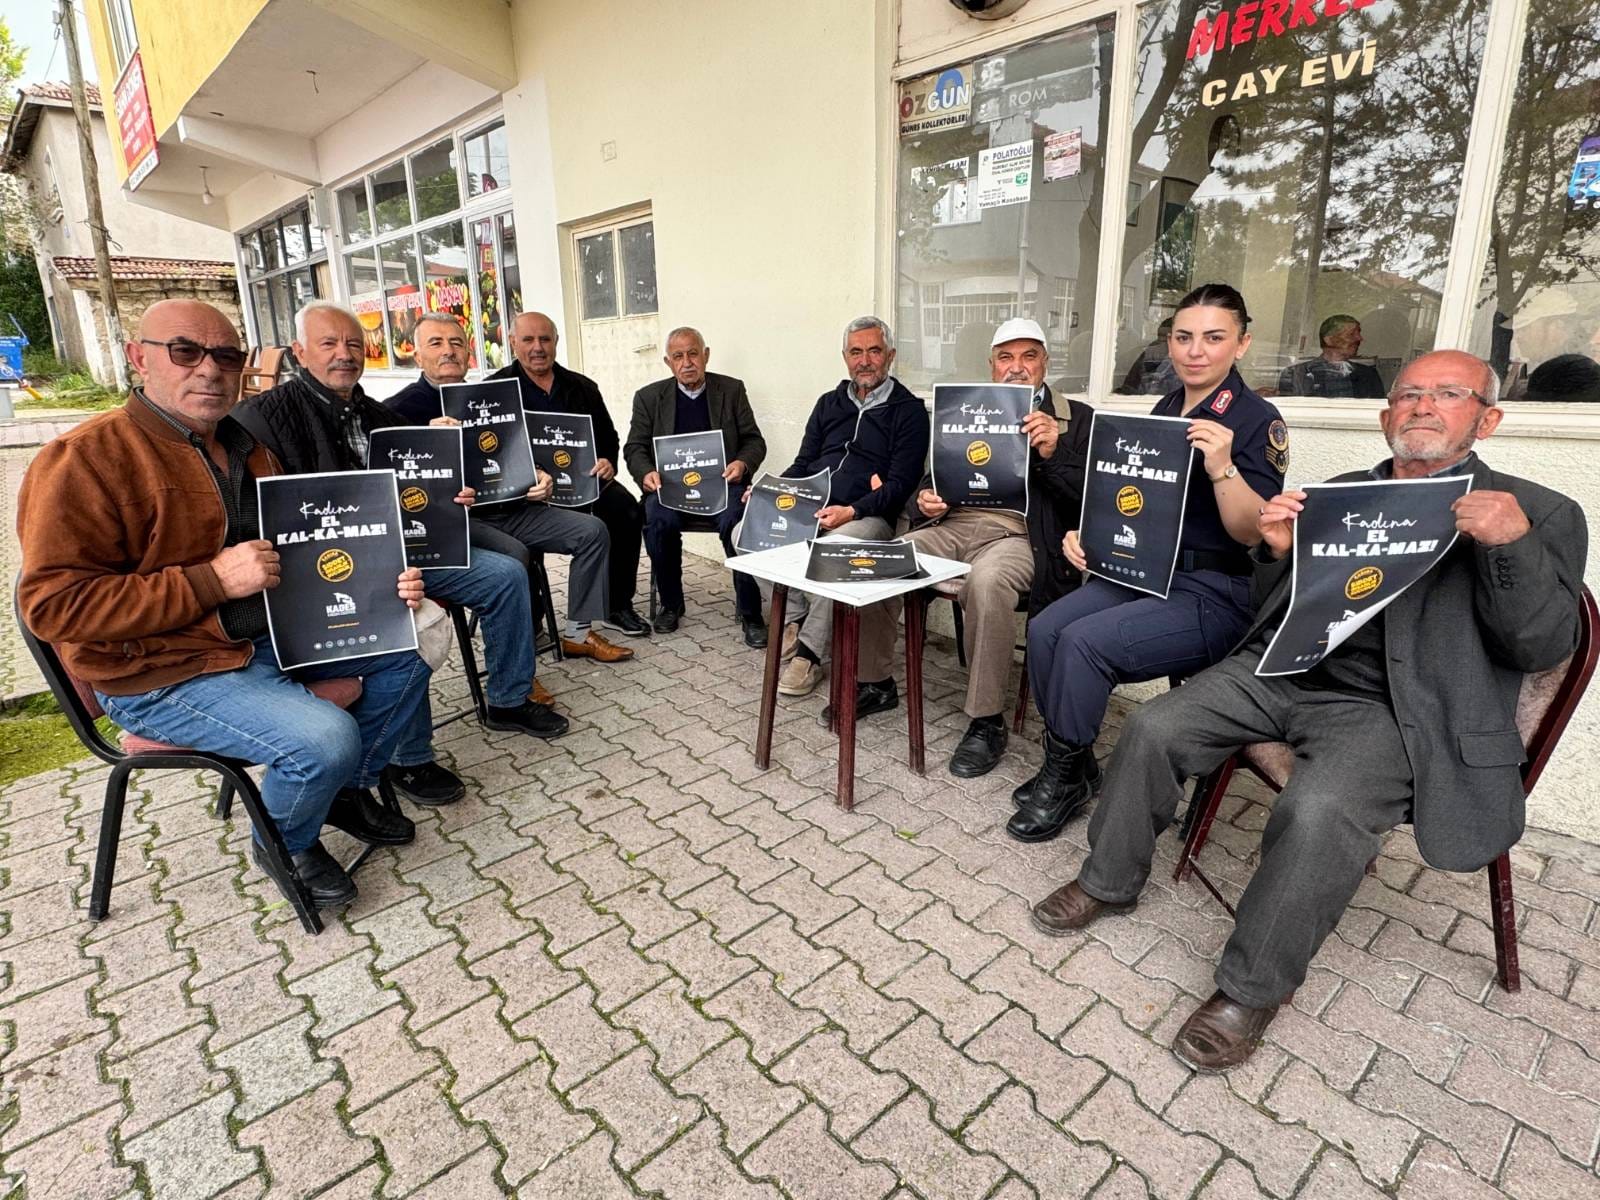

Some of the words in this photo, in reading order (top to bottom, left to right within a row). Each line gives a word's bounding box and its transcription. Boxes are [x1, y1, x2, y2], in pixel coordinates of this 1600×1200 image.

[1186, 0, 1376, 60] MERK
[479, 409, 491, 418] EL
[974, 415, 988, 425] EL
[462, 413, 516, 428] AL-KA-MAZ!
[942, 424, 1020, 434] KAL-KA-MAZ!
[532, 438, 588, 447] KAL-KA-MAZ!
[555, 433, 565, 441] EL
[403, 460, 419, 470] EL
[664, 458, 719, 471] KAL-KA-MAZ!
[685, 455, 696, 463] EL
[1127, 454, 1143, 467] EL
[395, 468, 453, 480] -KA-MAZ!
[1096, 460, 1178, 483] KAL-KA-MAZ!
[321, 515, 341, 528] EL
[277, 523, 387, 545] KAL-KA-MAZ!
[1366, 529, 1389, 543] EL
[1311, 539, 1439, 557] KAL-KA-MAZ!
